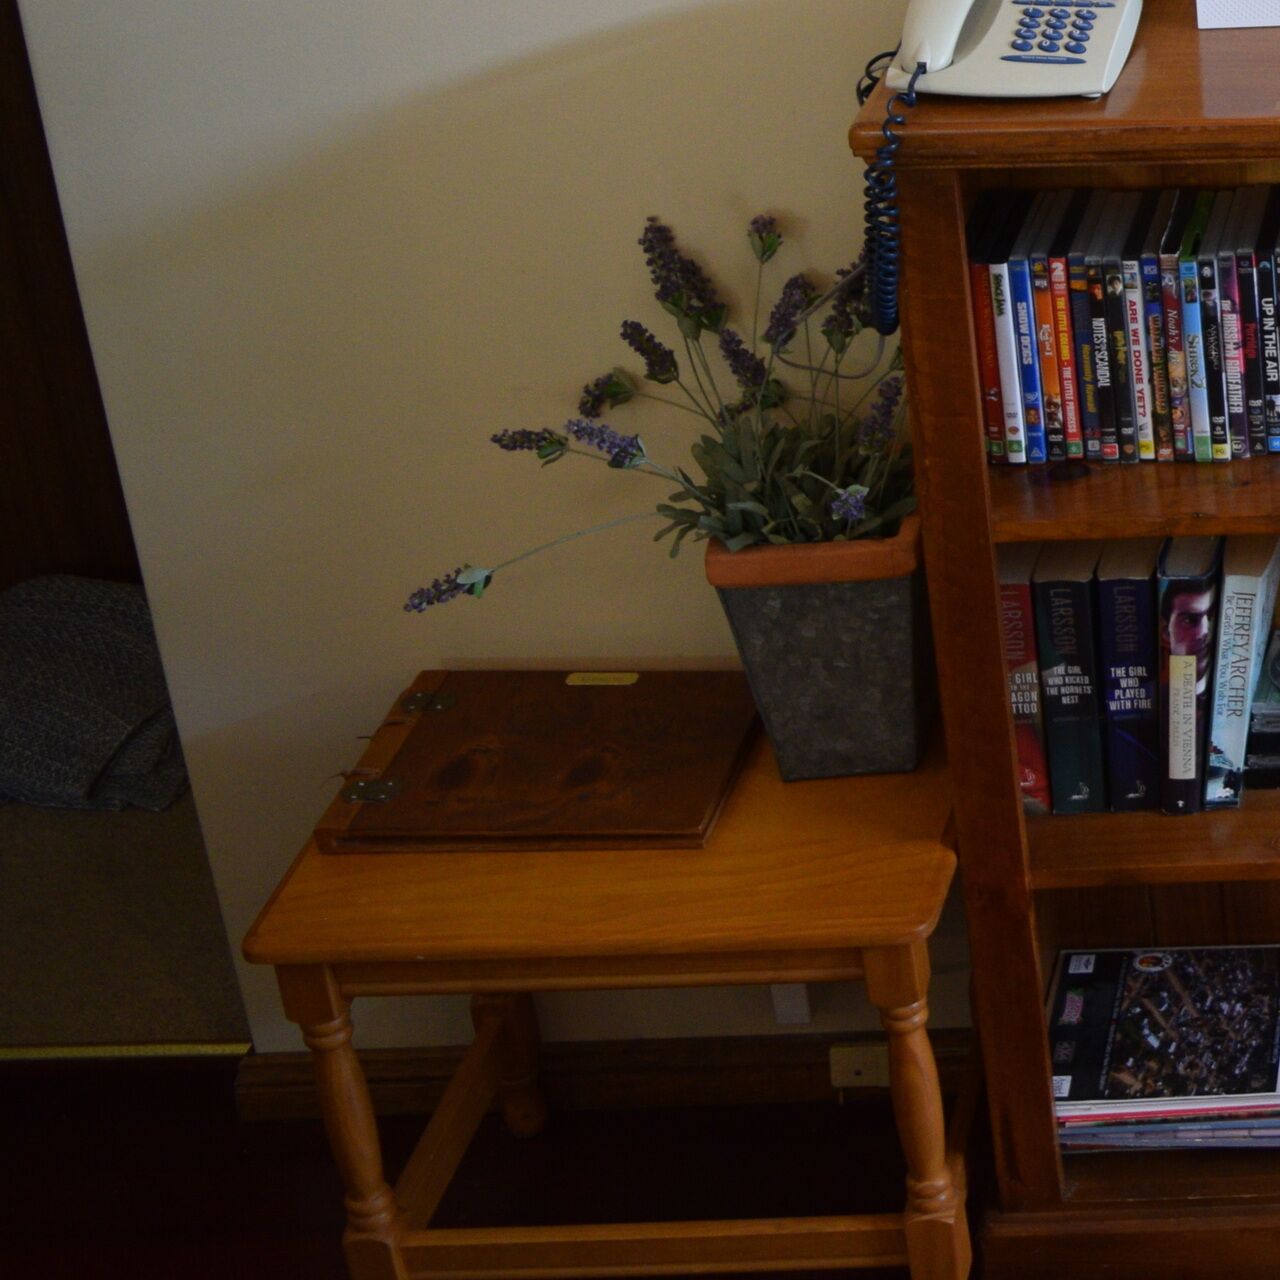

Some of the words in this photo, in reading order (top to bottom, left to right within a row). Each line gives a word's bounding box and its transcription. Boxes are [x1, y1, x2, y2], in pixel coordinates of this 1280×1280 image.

[1017, 302, 1029, 333] SNOW
[1128, 301, 1137, 323] ARE
[1261, 298, 1273, 315] UP
[1263, 318, 1273, 330] IN
[1131, 329, 1139, 346] WE
[1264, 332, 1276, 357] THE
[1020, 336, 1032, 365] DOGS
[1133, 350, 1144, 384] DONE
[1266, 360, 1278, 381] AIR
[1137, 388, 1146, 417] YET?
[1001, 590, 1026, 661] LARSSON
[1050, 588, 1078, 655] LARSSON
[1113, 585, 1139, 653] LARSSON
[1231, 591, 1256, 651] JEFFREY
[1048, 677, 1064, 686] WHO
[1065, 675, 1090, 685] KICKED
[1110, 667, 1126, 678] THE
[1128, 666, 1148, 677] GIRL
[1119, 677, 1139, 688] WHO
[1114, 688, 1146, 699] PLAYED
[1183, 673, 1192, 709] DEATH
[1227, 652, 1251, 717] ARCHER
[1061, 695, 1079, 705] NEST
[1108, 700, 1133, 711] WITH
[1133, 698, 1152, 709] FIRE
[1183, 713, 1192, 724] IN
[1183, 728, 1192, 773] VIENNA
